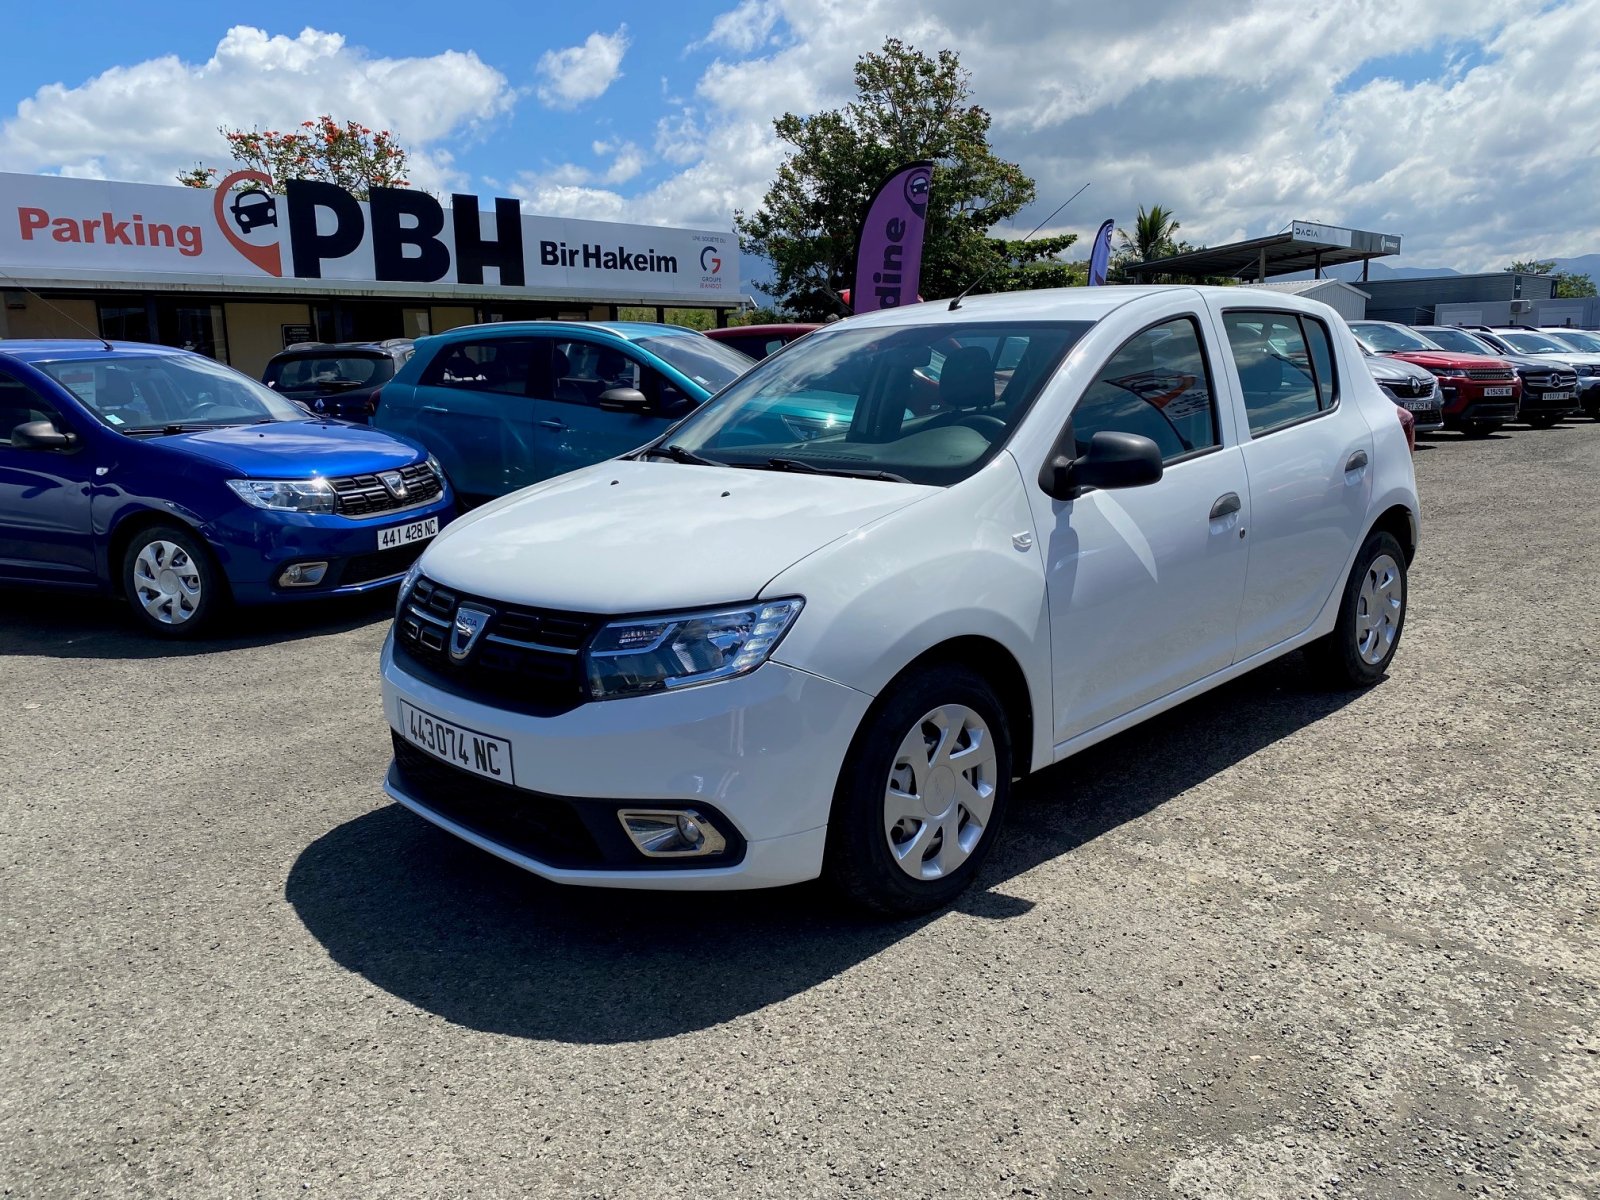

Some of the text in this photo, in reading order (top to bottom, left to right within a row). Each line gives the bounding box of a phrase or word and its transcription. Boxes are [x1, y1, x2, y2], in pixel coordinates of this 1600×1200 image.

[18, 206, 204, 257] Parking
[286, 179, 525, 287] PBH
[1295, 228, 1319, 238] DACIA
[382, 519, 436, 547] 441 428 NC
[457, 615, 478, 628] DACIA
[410, 709, 501, 776] 443074 NC
